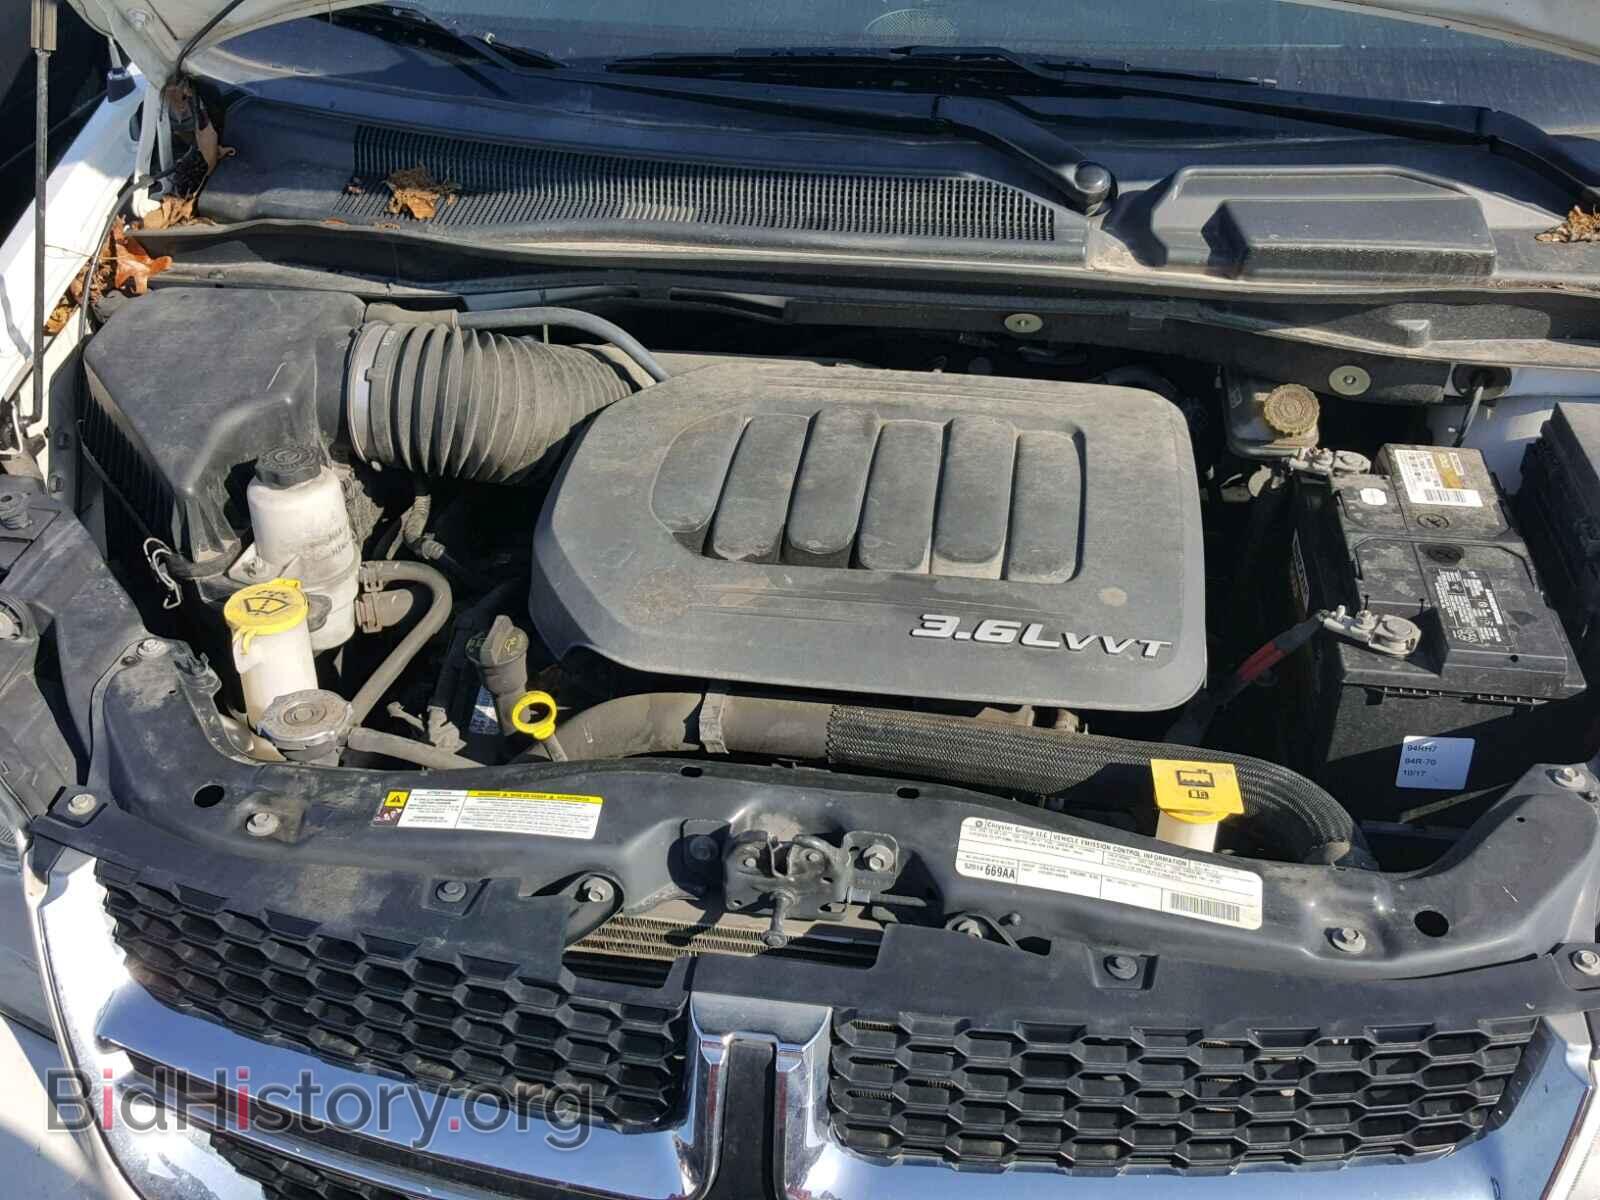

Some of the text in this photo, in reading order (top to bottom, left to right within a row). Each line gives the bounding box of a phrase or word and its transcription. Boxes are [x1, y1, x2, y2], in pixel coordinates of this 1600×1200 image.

[987, 822, 1013, 831] Chrysler
[1015, 826, 1034, 836] Group
[1053, 834, 1187, 866] VEHICLE EMISSION CONTROL INFORMATION
